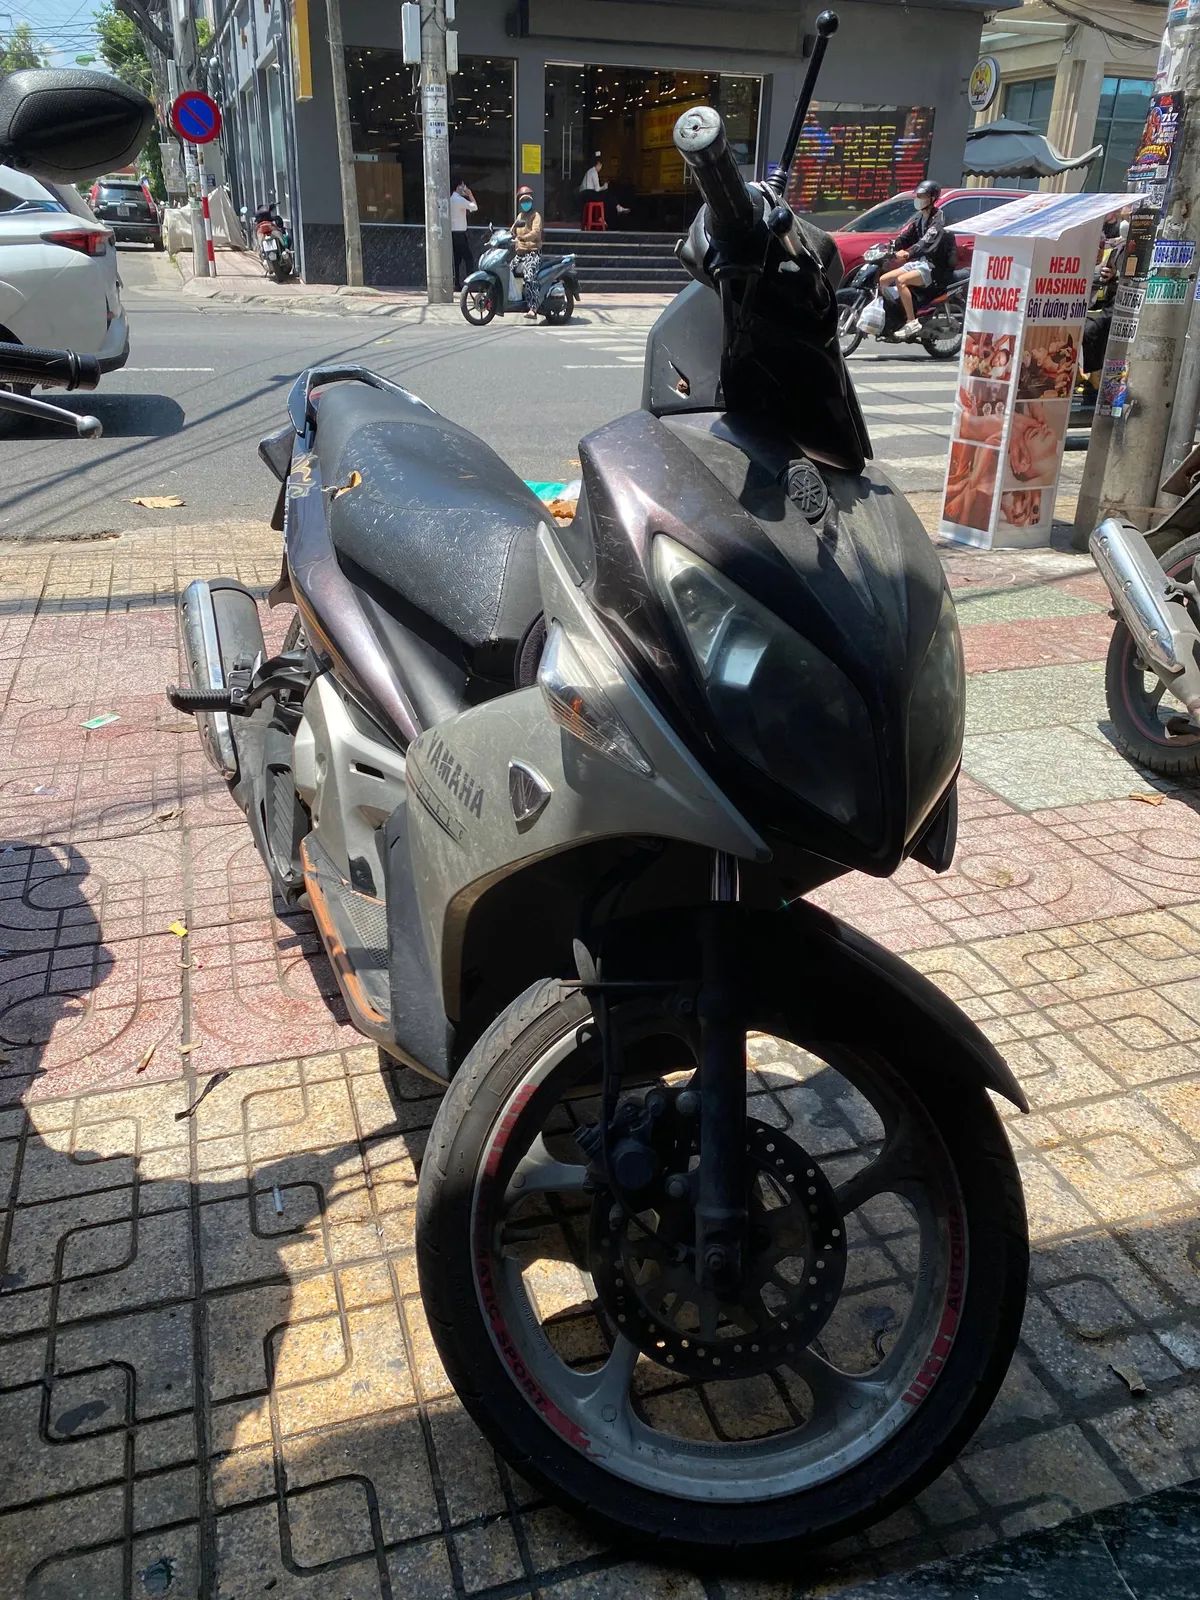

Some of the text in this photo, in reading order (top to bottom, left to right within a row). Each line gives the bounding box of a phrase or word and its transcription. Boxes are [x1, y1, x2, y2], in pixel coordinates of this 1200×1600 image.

[986, 256, 1014, 281] FOOT
[1049, 256, 1081, 274] HEAD
[1035, 277, 1087, 295] WASHING
[971, 286, 1021, 312] MASSAGE
[1069, 298, 1088, 319] sinh
[426, 731, 485, 819] YAMAHA
[496, 1328, 549, 1411] SPORT
